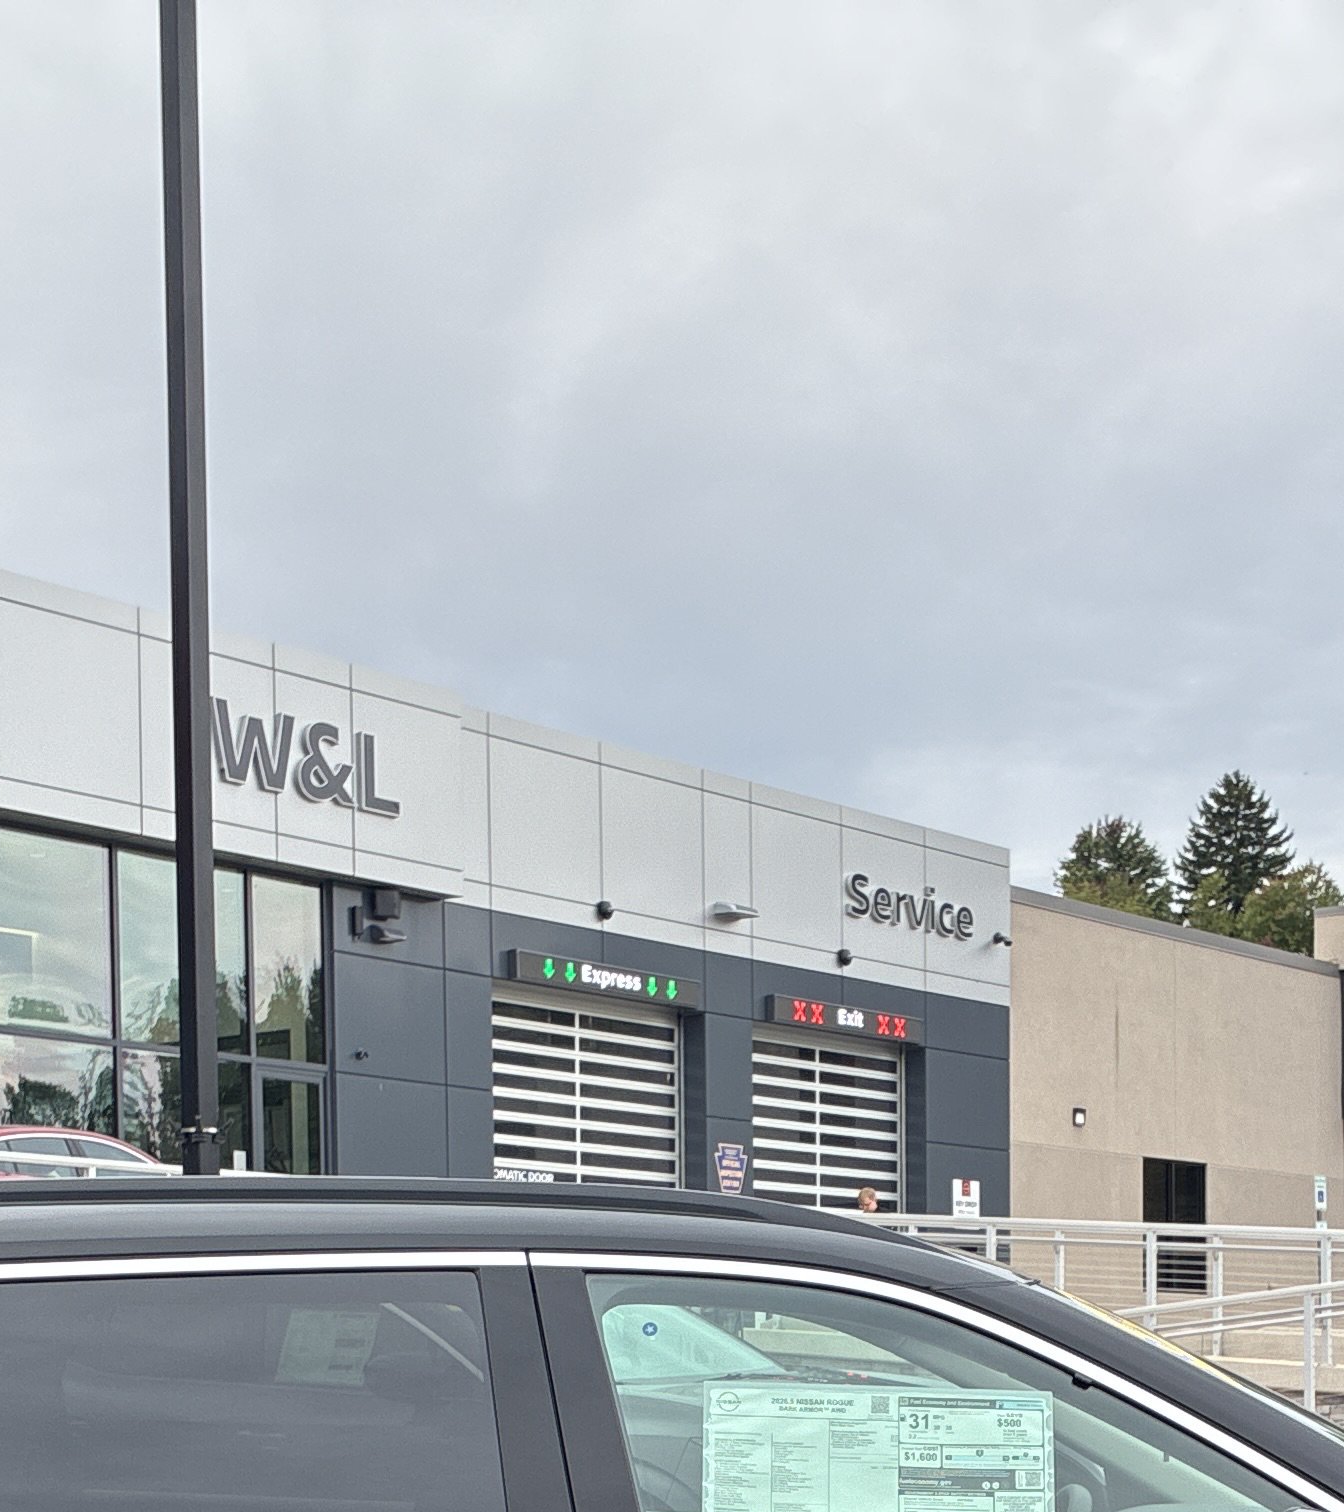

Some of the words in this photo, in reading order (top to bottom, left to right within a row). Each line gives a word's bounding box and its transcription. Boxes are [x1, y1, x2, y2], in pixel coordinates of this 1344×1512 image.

[210, 697, 400, 818] W&L
[845, 873, 974, 941] Service
[581, 964, 642, 992] Express
[837, 1008, 864, 1028] Exit
[528, 1171, 555, 1183] DOOR
[796, 1398, 825, 1406] NISSAN
[909, 1413, 929, 1430] 31
[997, 1417, 1022, 1428] $500
[905, 1451, 938, 1462] $1,600
